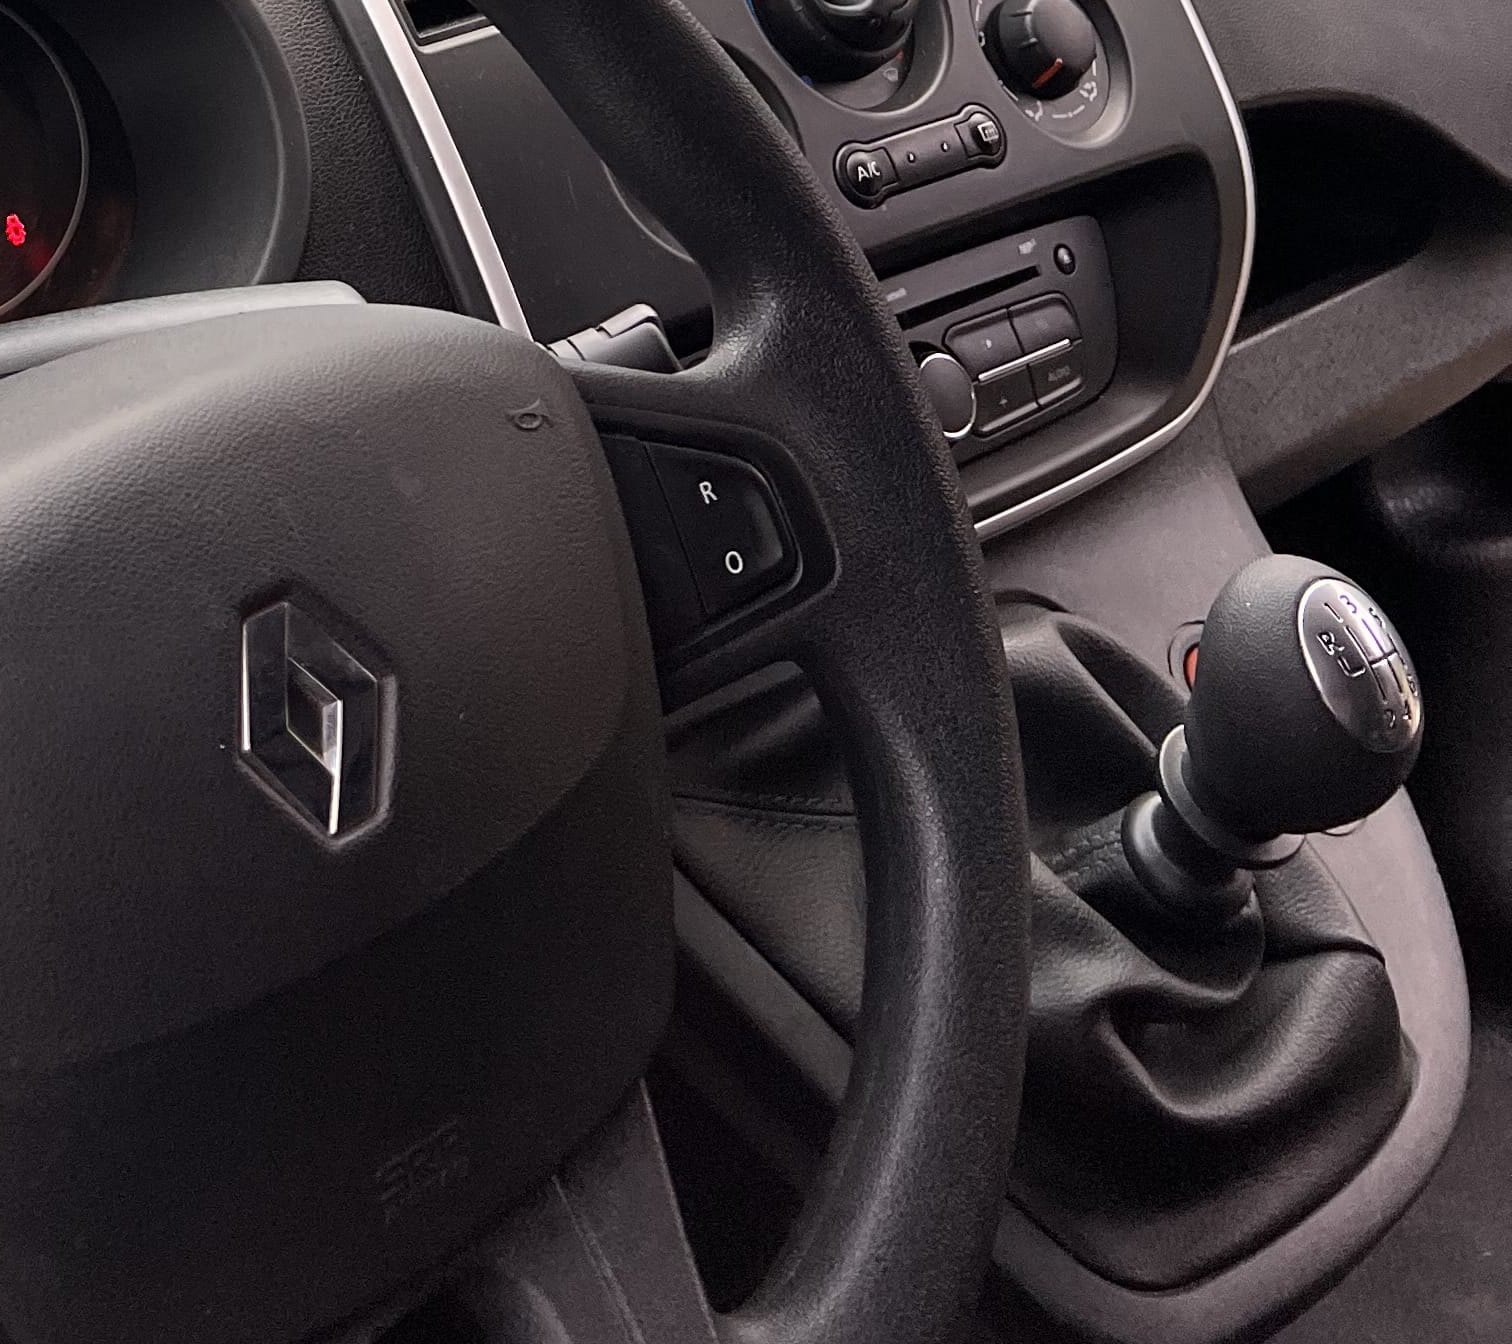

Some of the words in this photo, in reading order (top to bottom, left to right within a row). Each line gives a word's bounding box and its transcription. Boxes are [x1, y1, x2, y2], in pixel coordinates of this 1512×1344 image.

[857, 161, 881, 183] A/C
[699, 481, 718, 505] R
[1339, 594, 1358, 614] 3
